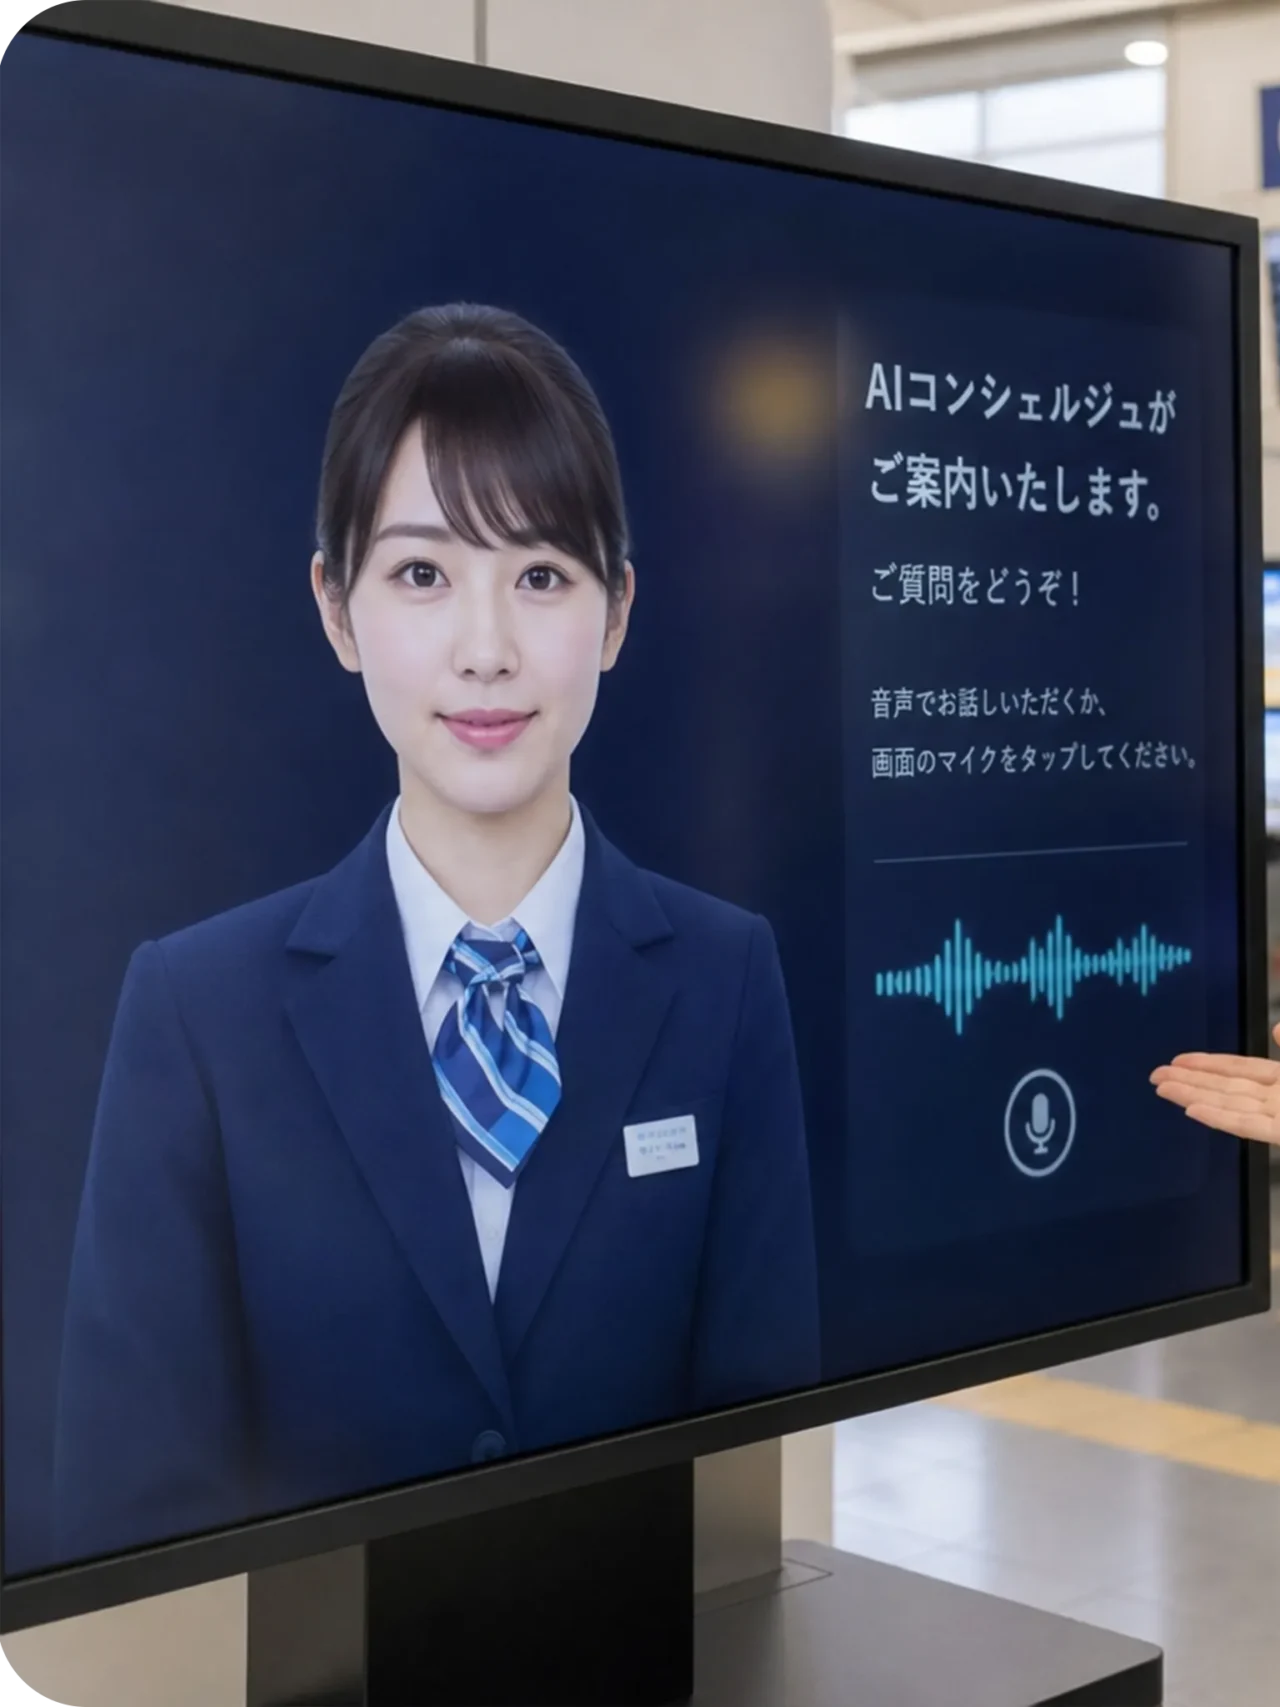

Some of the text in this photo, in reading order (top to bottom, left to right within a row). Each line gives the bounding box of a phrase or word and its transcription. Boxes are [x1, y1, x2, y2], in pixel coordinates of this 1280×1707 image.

[865, 362, 1177, 434] AIコンシェルジュが
[870, 450, 1160, 522] ご案内いたします。
[871, 562, 1080, 607] ご質問をどうぞ！
[870, 686, 1107, 719] 音声でお話しいただくか、
[871, 740, 1197, 780] 画面のマイクをタップしてください。
